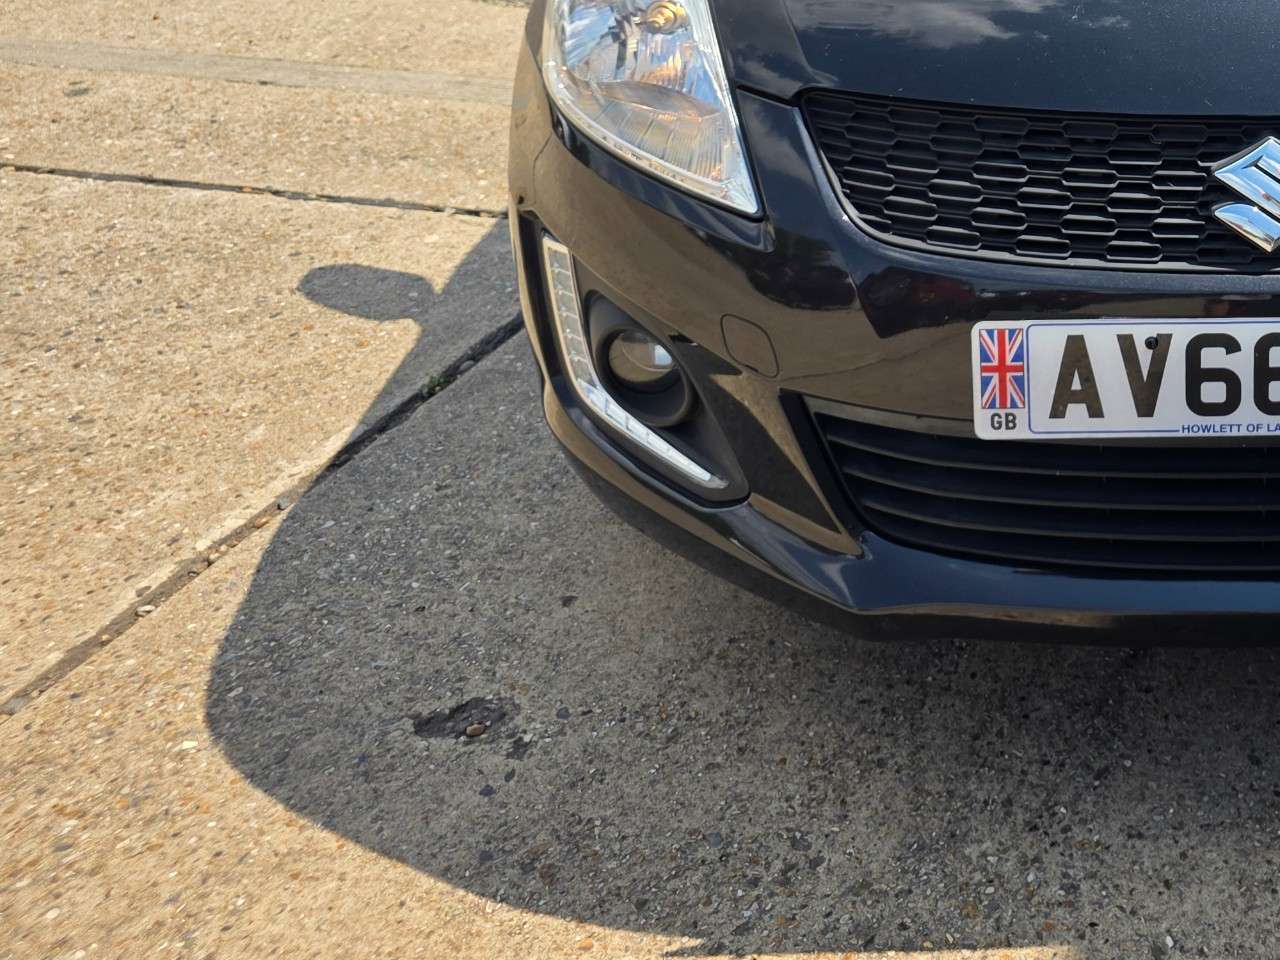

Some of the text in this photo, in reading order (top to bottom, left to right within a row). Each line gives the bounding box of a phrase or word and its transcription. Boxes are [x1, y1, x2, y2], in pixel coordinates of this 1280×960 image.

[990, 412, 1018, 431] GB
[1181, 423, 1243, 434] HOWLETT
[1246, 423, 1264, 433] OF
